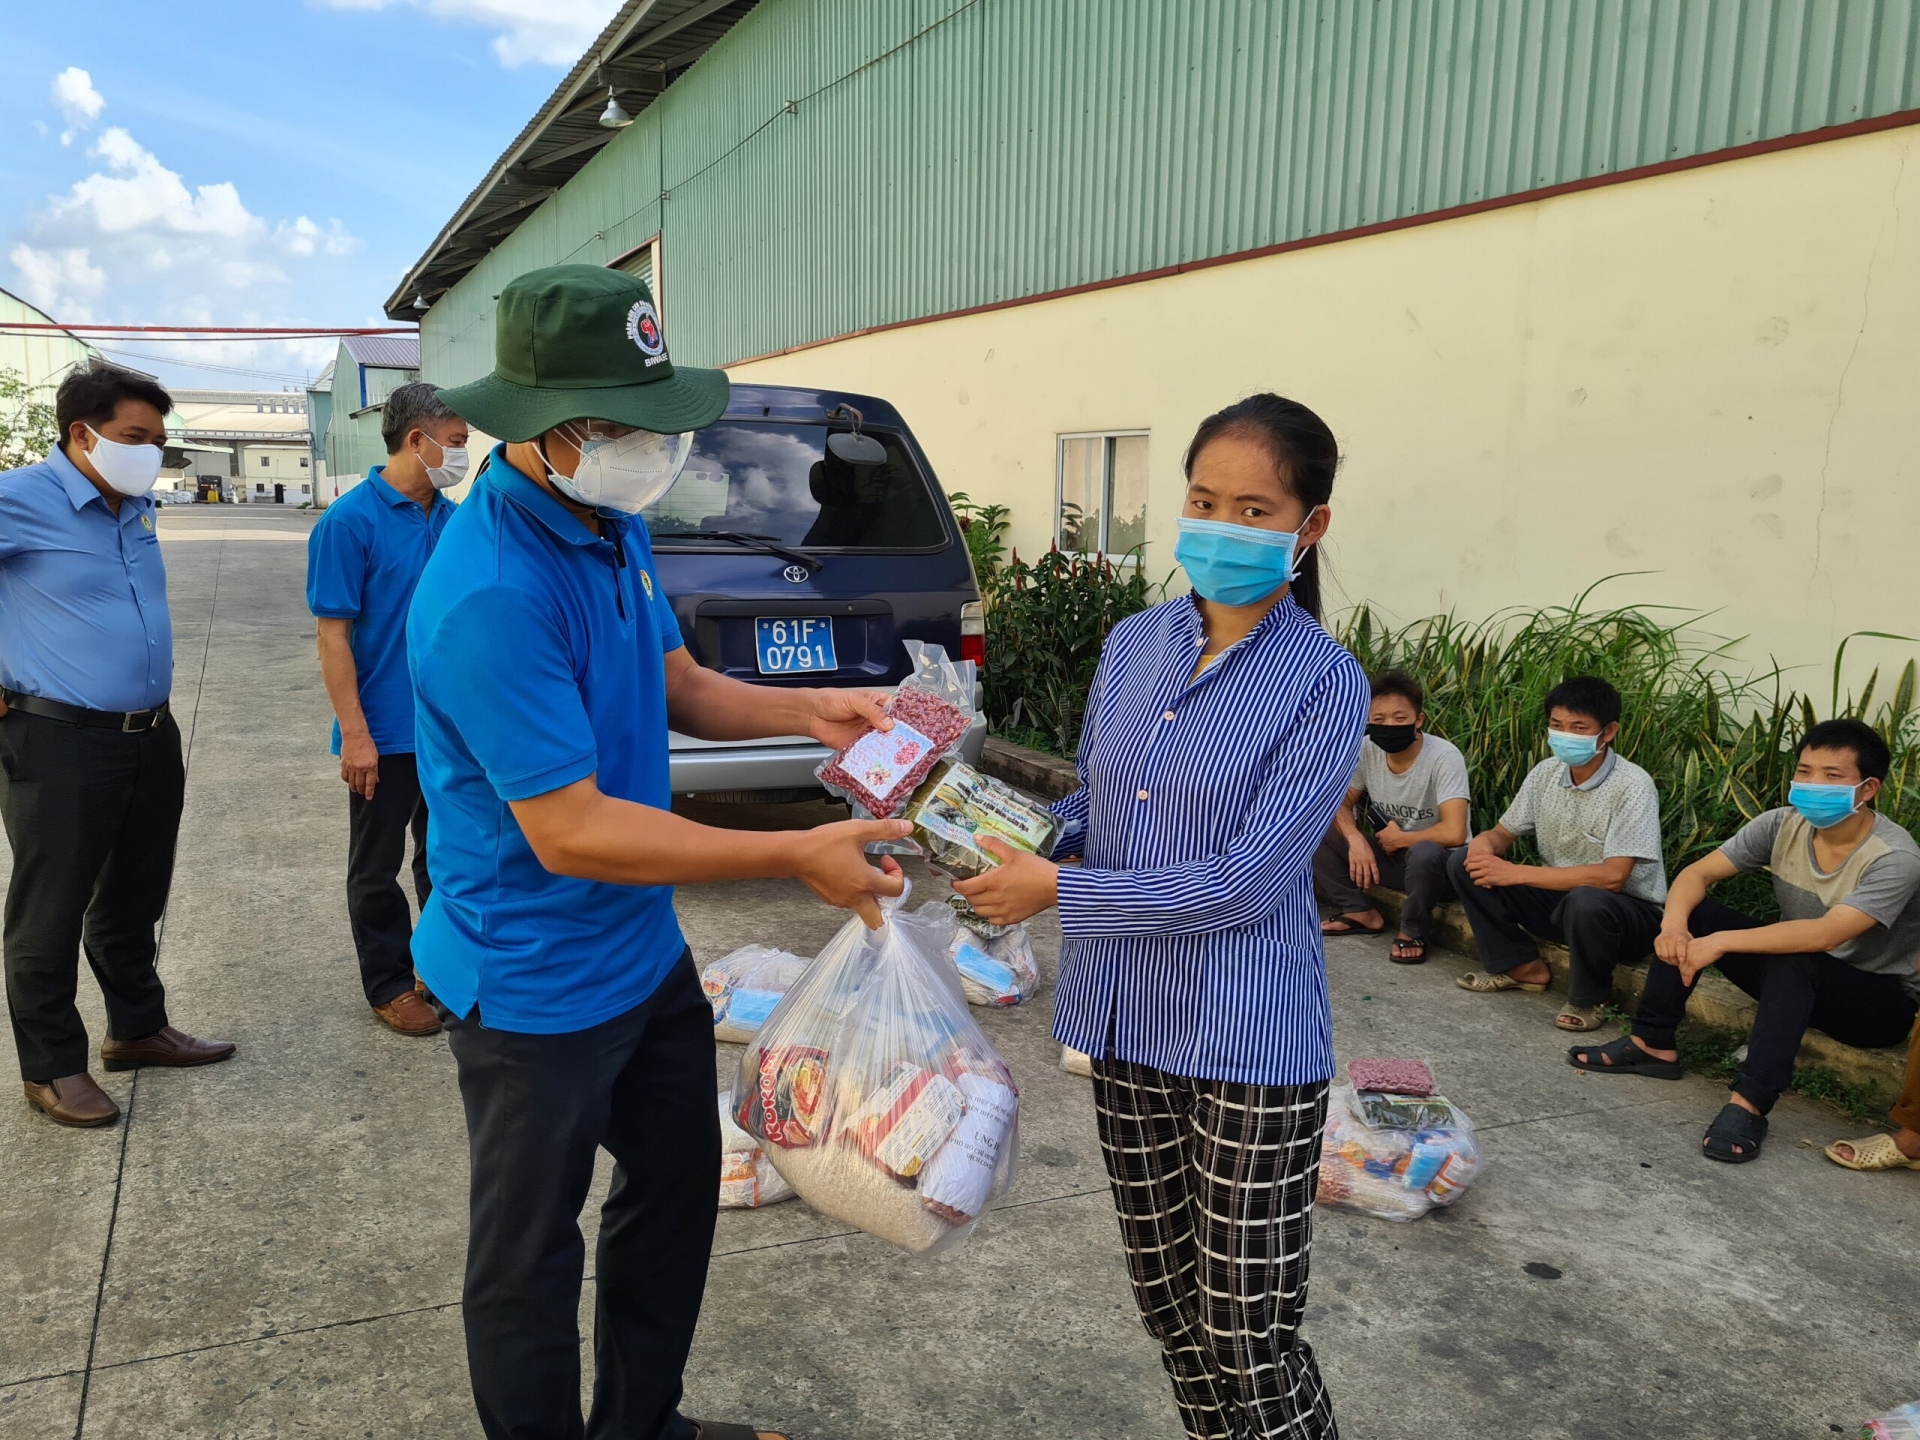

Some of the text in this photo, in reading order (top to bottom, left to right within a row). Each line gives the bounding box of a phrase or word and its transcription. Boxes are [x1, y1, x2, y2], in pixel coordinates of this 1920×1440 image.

[772, 619, 816, 645] 61F
[766, 645, 825, 670] 0791
[760, 1052, 783, 1141] KOKOM
